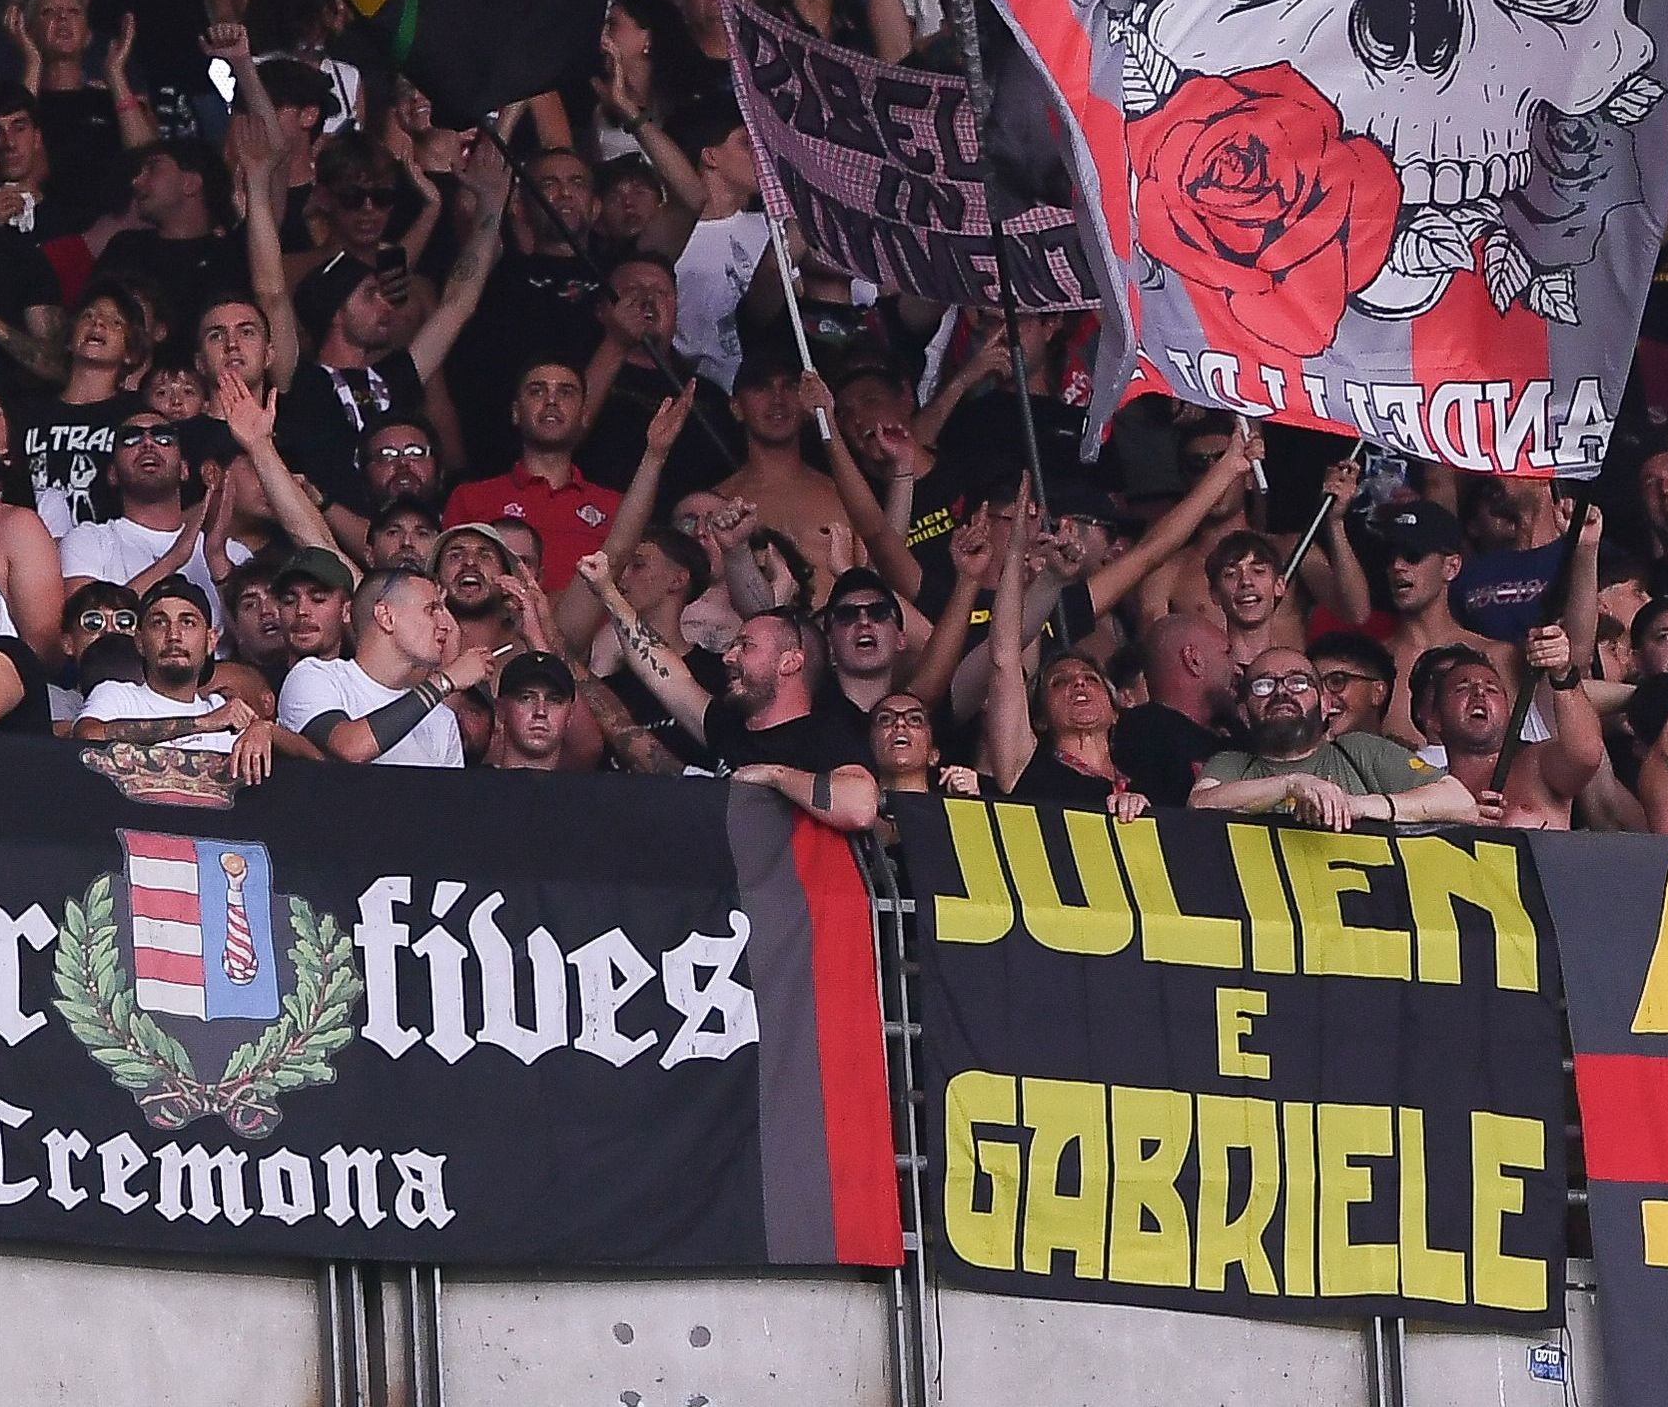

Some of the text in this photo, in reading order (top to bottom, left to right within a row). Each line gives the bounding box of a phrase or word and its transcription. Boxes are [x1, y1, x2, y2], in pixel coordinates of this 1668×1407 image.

[354, 872, 761, 1072] fives
[934, 796, 1540, 993] JULIEN
[1215, 986, 1272, 1080] E
[944, 1069, 1549, 1312] GABRIELE
